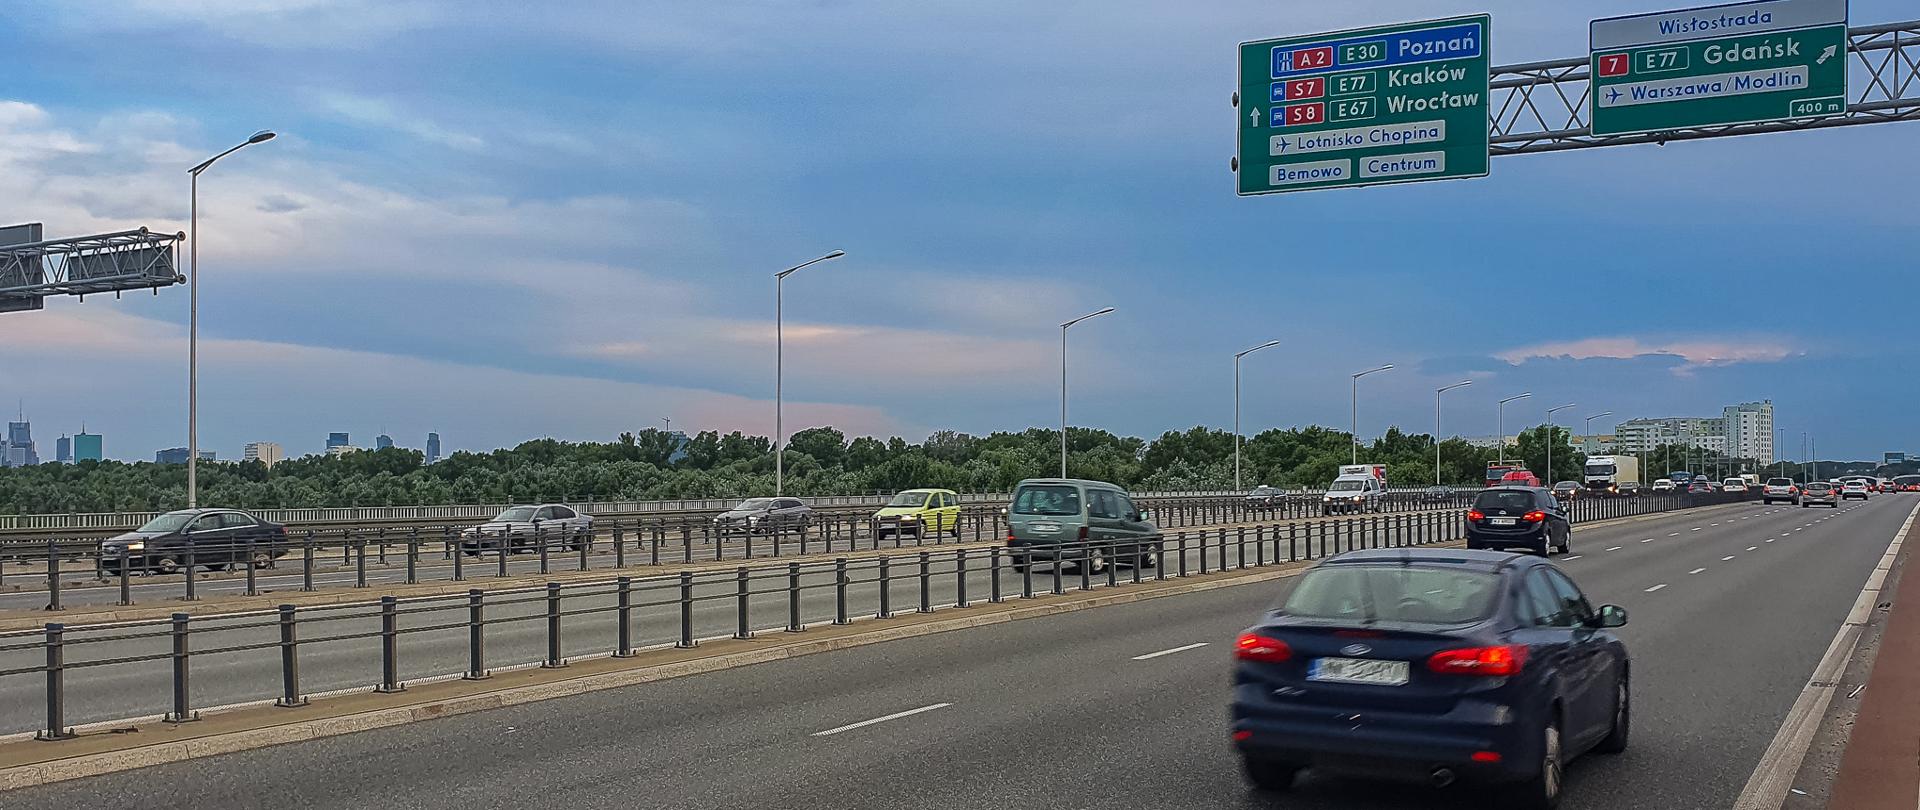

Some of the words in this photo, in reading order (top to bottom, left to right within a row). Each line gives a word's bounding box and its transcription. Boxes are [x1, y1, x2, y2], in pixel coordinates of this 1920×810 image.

[1658, 10, 1772, 36] Wisłostrada
[1399, 32, 1474, 57] Poznań
[1608, 58, 1619, 73] 7
[1703, 37, 1800, 65] Gdańsk
[1388, 65, 1466, 87] Kraków
[1630, 71, 1802, 101] Warszawa/Modlin
[1388, 91, 1479, 113] Wrocław
[1797, 102, 1823, 114] 400
[1828, 102, 1839, 112] m
[1298, 132, 1363, 150] Lotnisko
[1369, 125, 1439, 146] Chopina
[1277, 166, 1343, 182] Bemowo
[1367, 157, 1437, 174] Centrum
